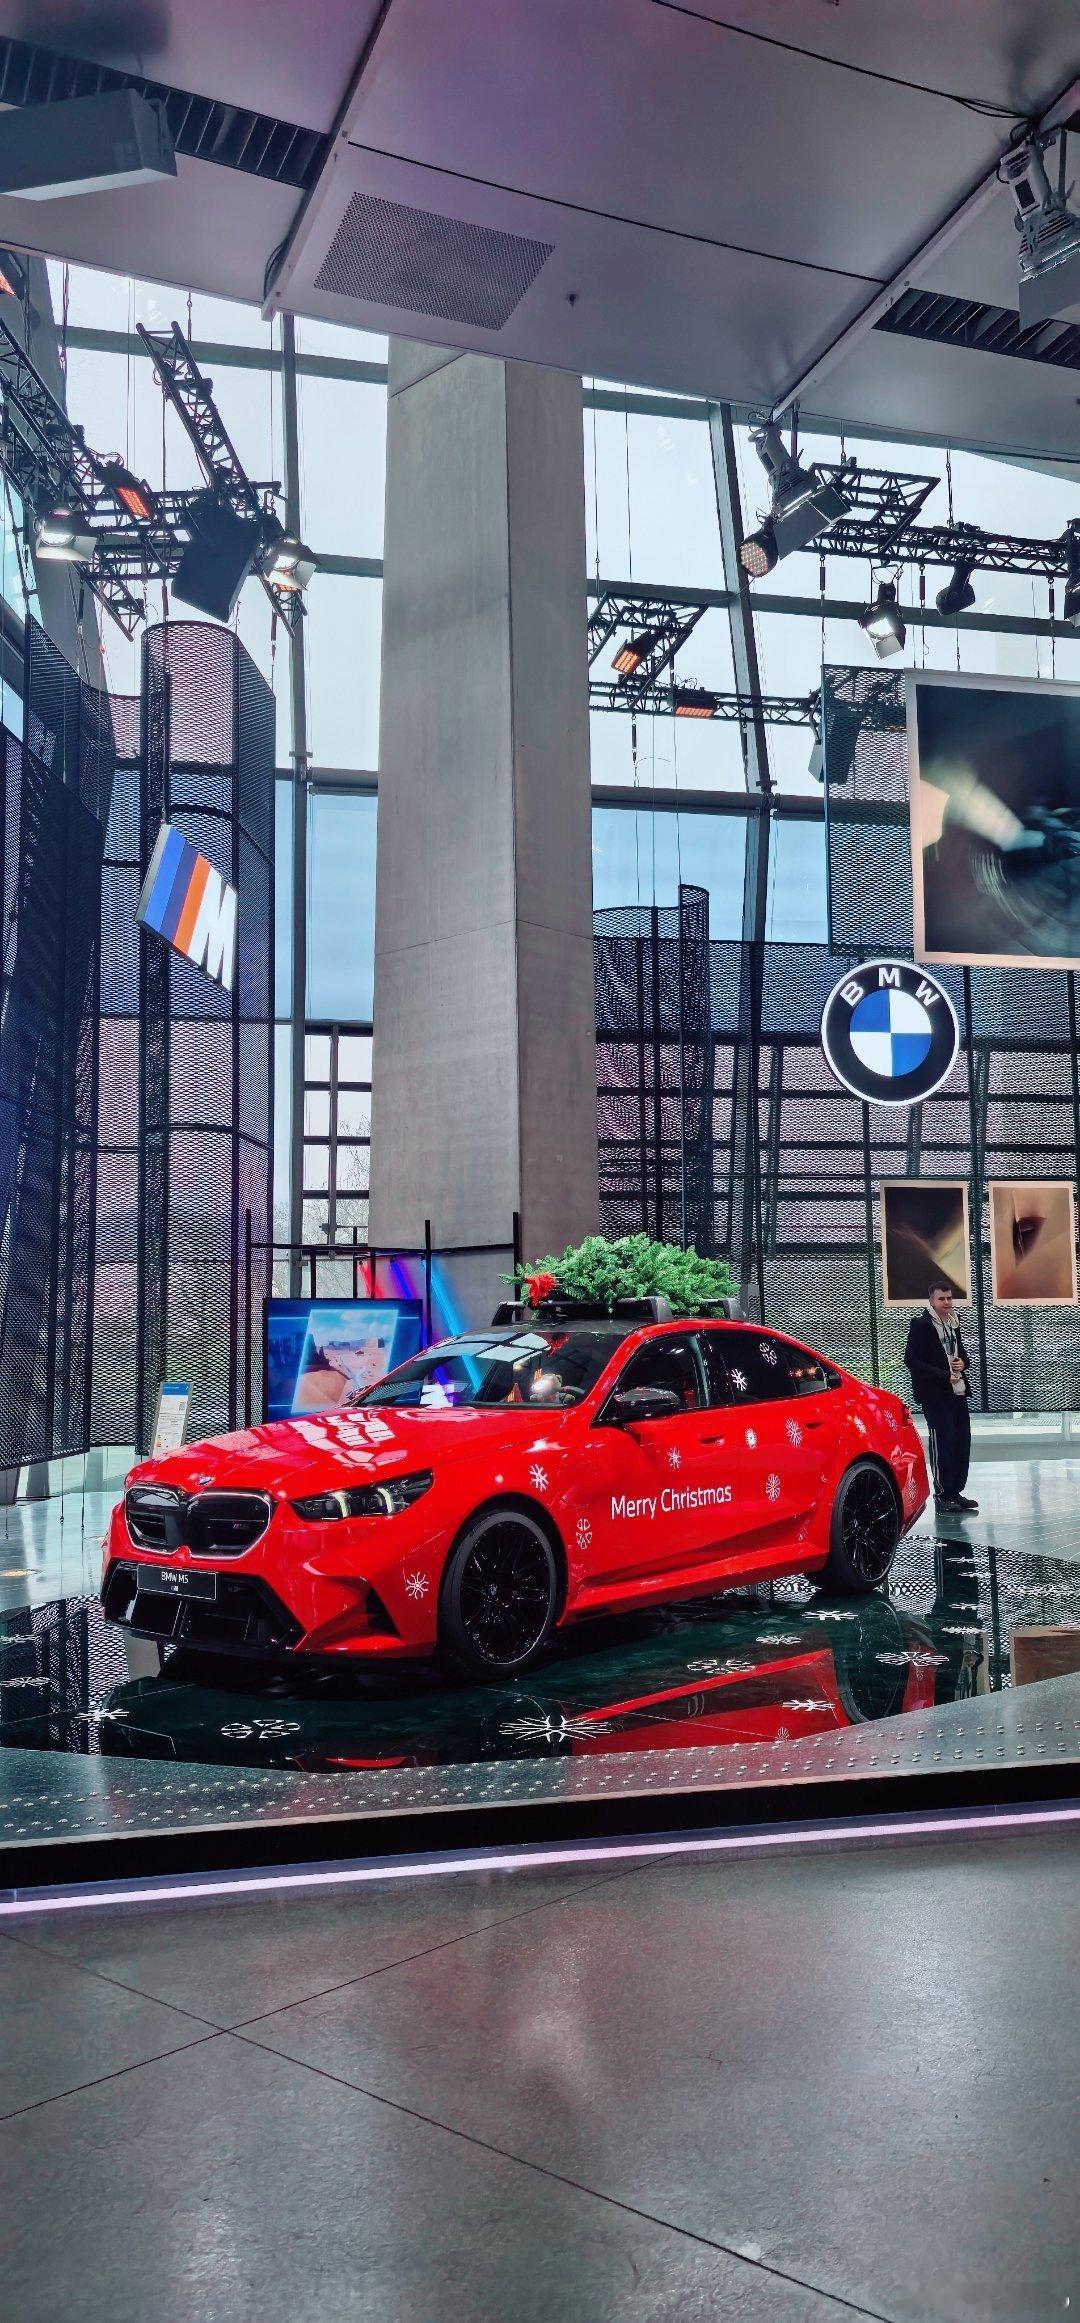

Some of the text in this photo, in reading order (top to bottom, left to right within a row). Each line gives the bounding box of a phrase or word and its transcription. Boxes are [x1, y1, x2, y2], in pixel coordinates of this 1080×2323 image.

[839, 967, 941, 1007] BMW
[611, 1485, 732, 1520] Merry Christmas
[161, 1571, 189, 1584] BMW M5
